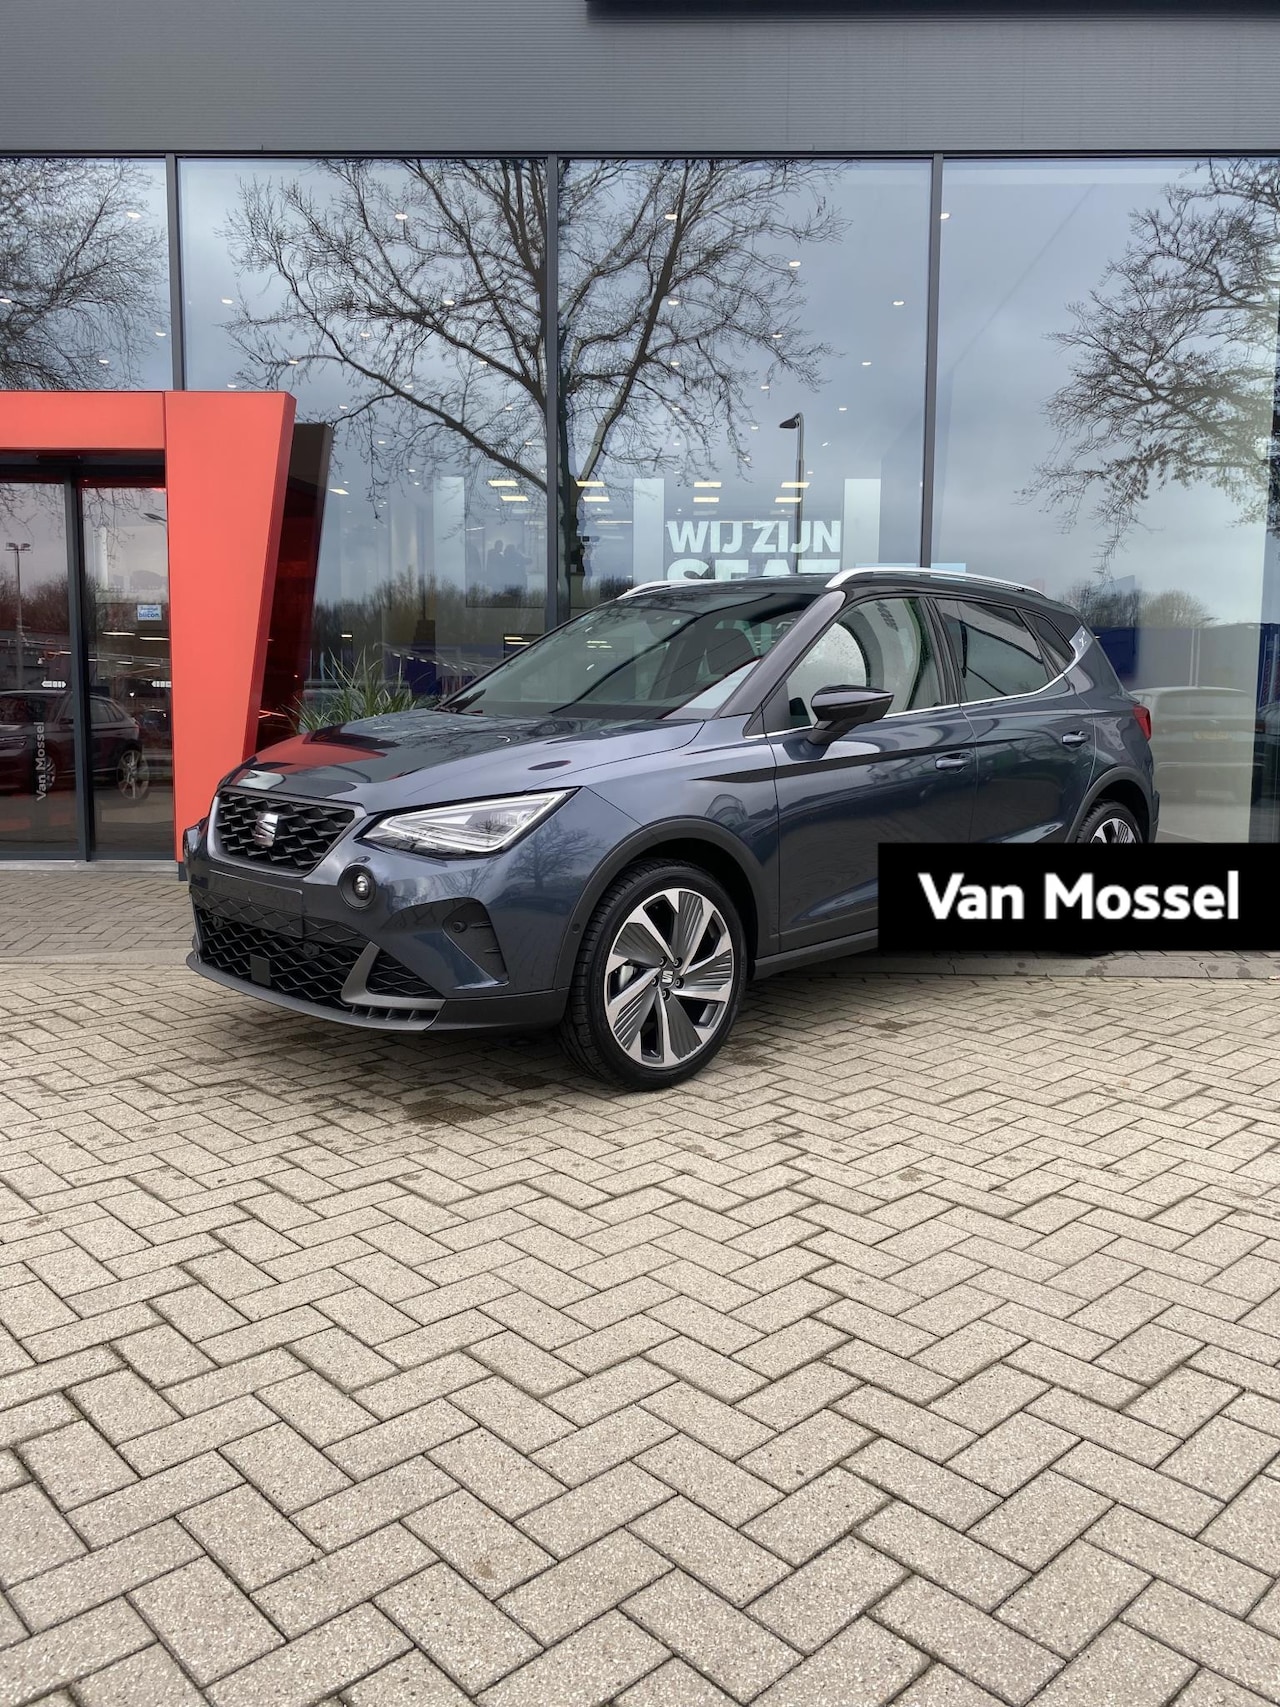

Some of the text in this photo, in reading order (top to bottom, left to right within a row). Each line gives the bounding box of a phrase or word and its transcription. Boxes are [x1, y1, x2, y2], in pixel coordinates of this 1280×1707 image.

[667, 520, 842, 553] WIJ ZIJN
[33, 721, 47, 801] Van Mossel
